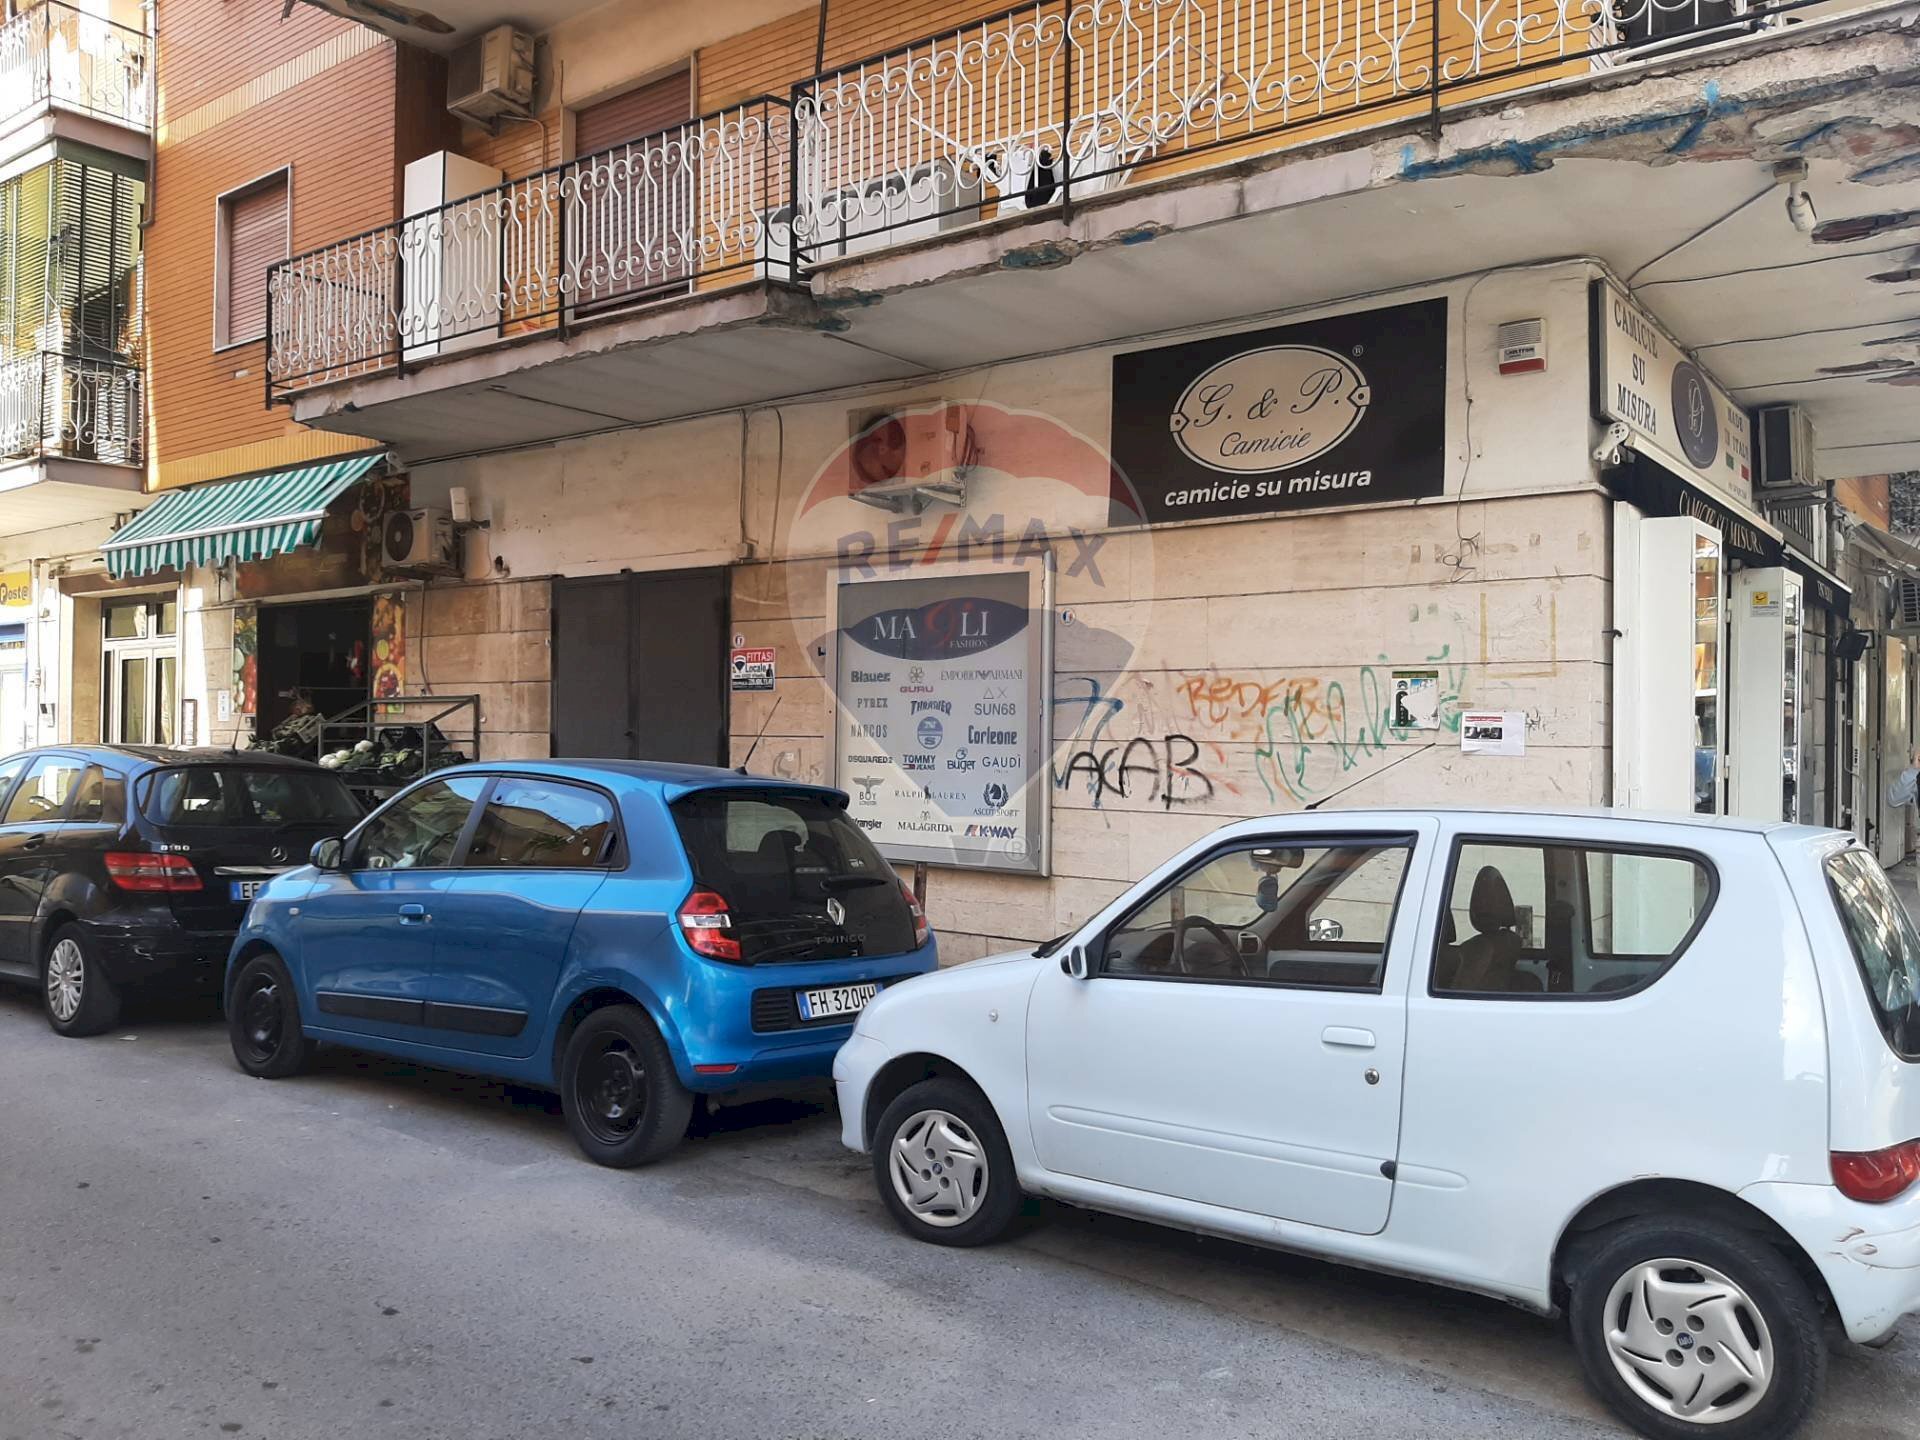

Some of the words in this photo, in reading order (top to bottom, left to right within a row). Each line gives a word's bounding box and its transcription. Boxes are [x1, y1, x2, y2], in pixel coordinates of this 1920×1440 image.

[1614, 298, 1658, 359] CAMICIE
[1632, 353, 1646, 386] SU
[1193, 383, 1232, 428] G.
[1247, 388, 1279, 421] &
[1617, 382, 1657, 436] MISURA
[1219, 427, 1312, 457] Camicie
[1164, 477, 1249, 507] camicie
[1255, 479, 1282, 498] su
[1287, 468, 1372, 496] misura
[949, 638, 989, 650] FASHION
[746, 651, 774, 663] FITTASI
[899, 685, 934, 694] GURU
[857, 697, 889, 709] PYREX
[973, 702, 1017, 716] SUN68
[967, 724, 1018, 746] Corleone
[902, 754, 937, 764] TOMMY
[916, 763, 937, 771] JEANS
[1064, 733, 1215, 809] ACAB
[859, 791, 878, 801] BOY
[894, 790, 923, 798] RALPH
[930, 791, 967, 801] LAUREN
[896, 821, 954, 833] MALAGRIDA
